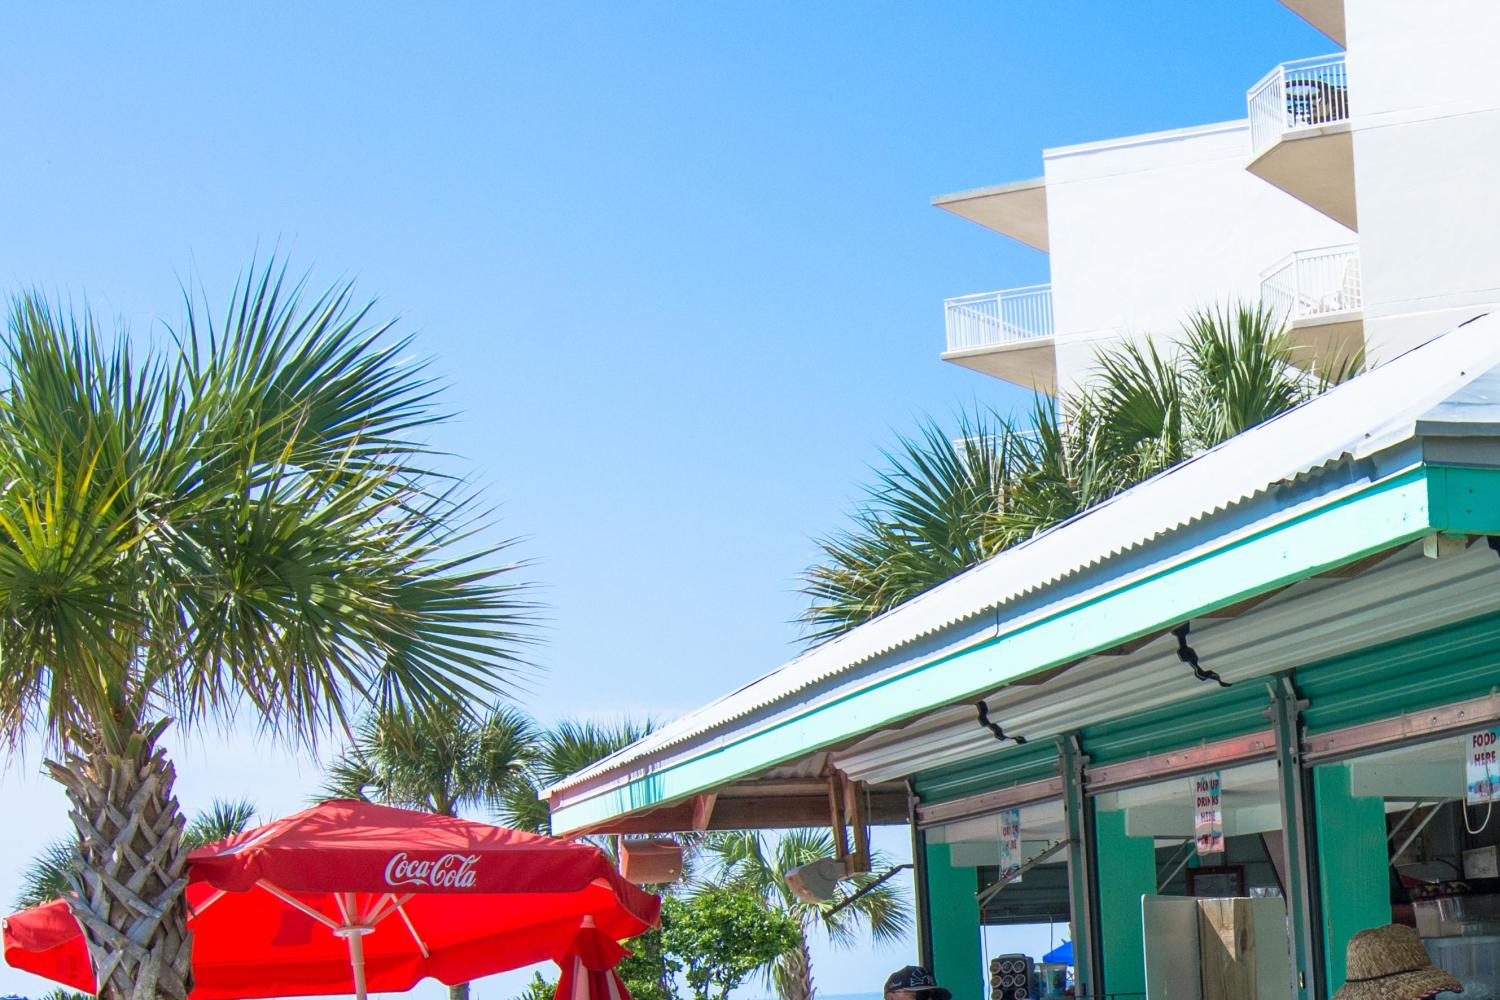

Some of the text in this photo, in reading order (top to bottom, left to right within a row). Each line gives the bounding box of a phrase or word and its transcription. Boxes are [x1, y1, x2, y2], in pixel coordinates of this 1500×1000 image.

[1472, 732, 1497, 748] FOOD
[1474, 750, 1496, 767] HERE
[384, 852, 482, 888] Coca-Cola
